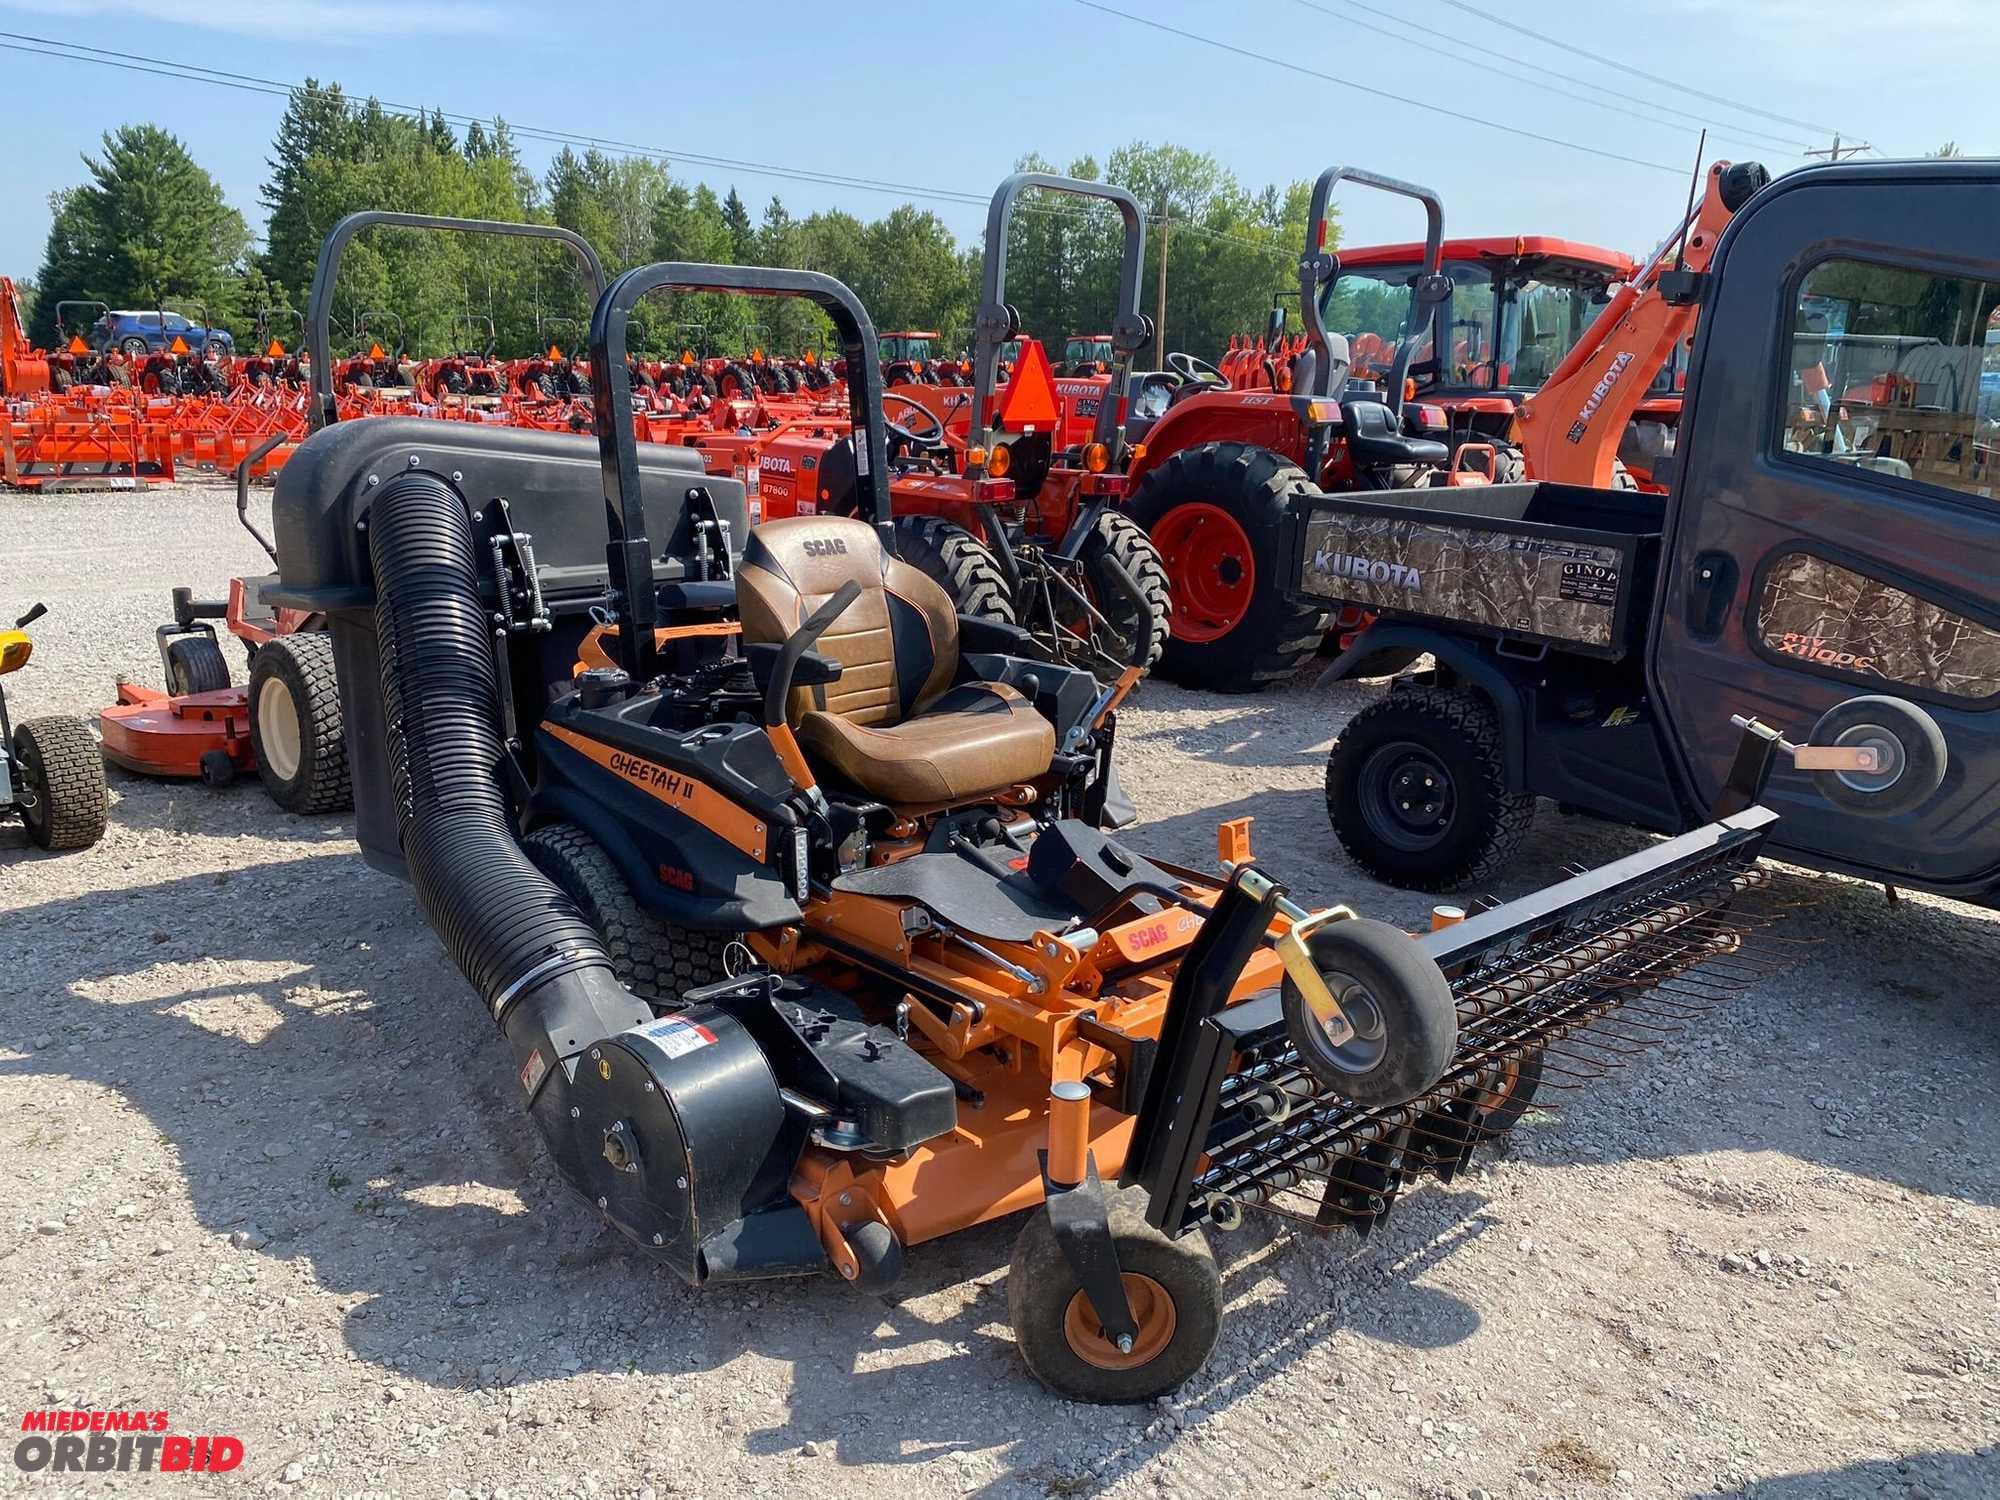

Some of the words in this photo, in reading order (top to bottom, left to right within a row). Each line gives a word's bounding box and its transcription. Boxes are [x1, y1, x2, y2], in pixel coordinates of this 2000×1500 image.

[1055, 383, 1100, 396] KUBOTA
[1578, 351, 1636, 421] KUBOTA
[762, 483, 789, 497] B7800
[802, 538, 848, 557] SCAG
[1314, 550, 1423, 593] KUBOTA
[610, 753, 682, 795] CHEETAH
[658, 863, 694, 892] SCAG
[1129, 923, 1169, 951] SCAG
